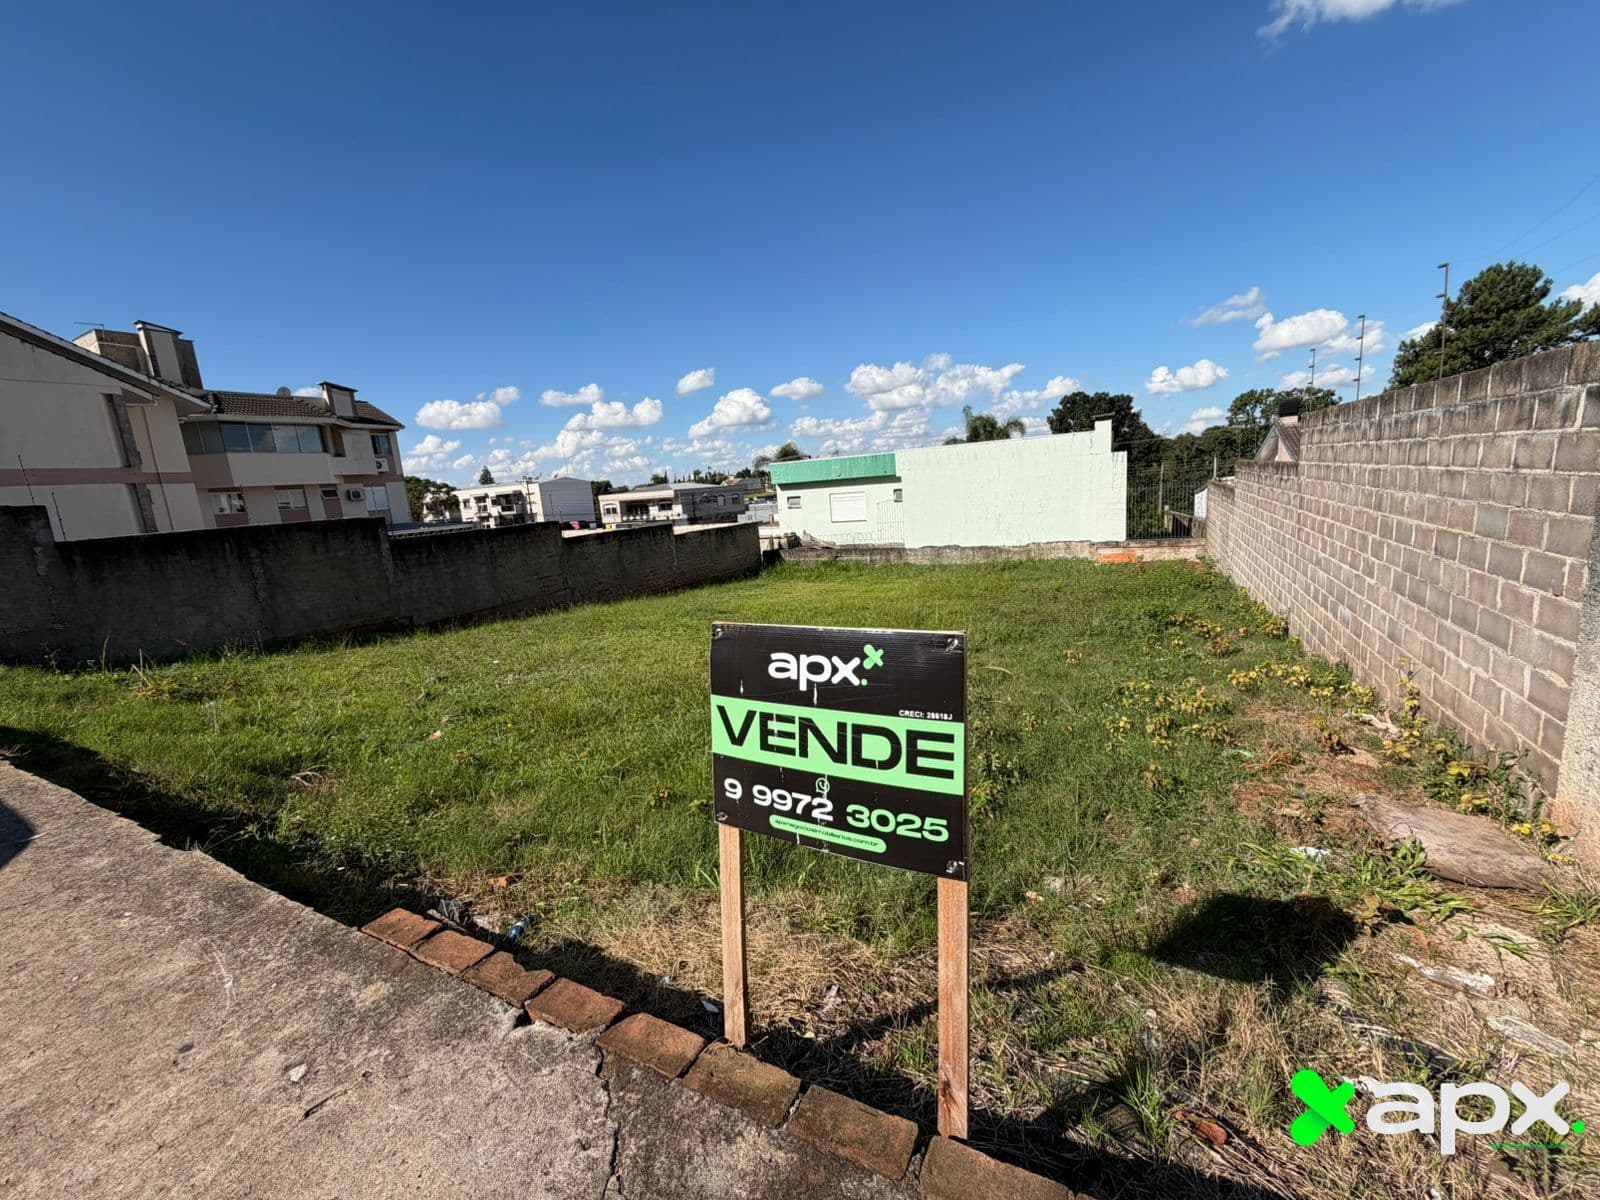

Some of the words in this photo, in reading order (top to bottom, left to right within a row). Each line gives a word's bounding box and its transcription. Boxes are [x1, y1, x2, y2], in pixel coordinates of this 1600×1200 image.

[716, 704, 955, 780] VENDE
[724, 778, 742, 800] 9
[752, 785, 833, 821] 9972
[846, 804, 949, 842] 3025
